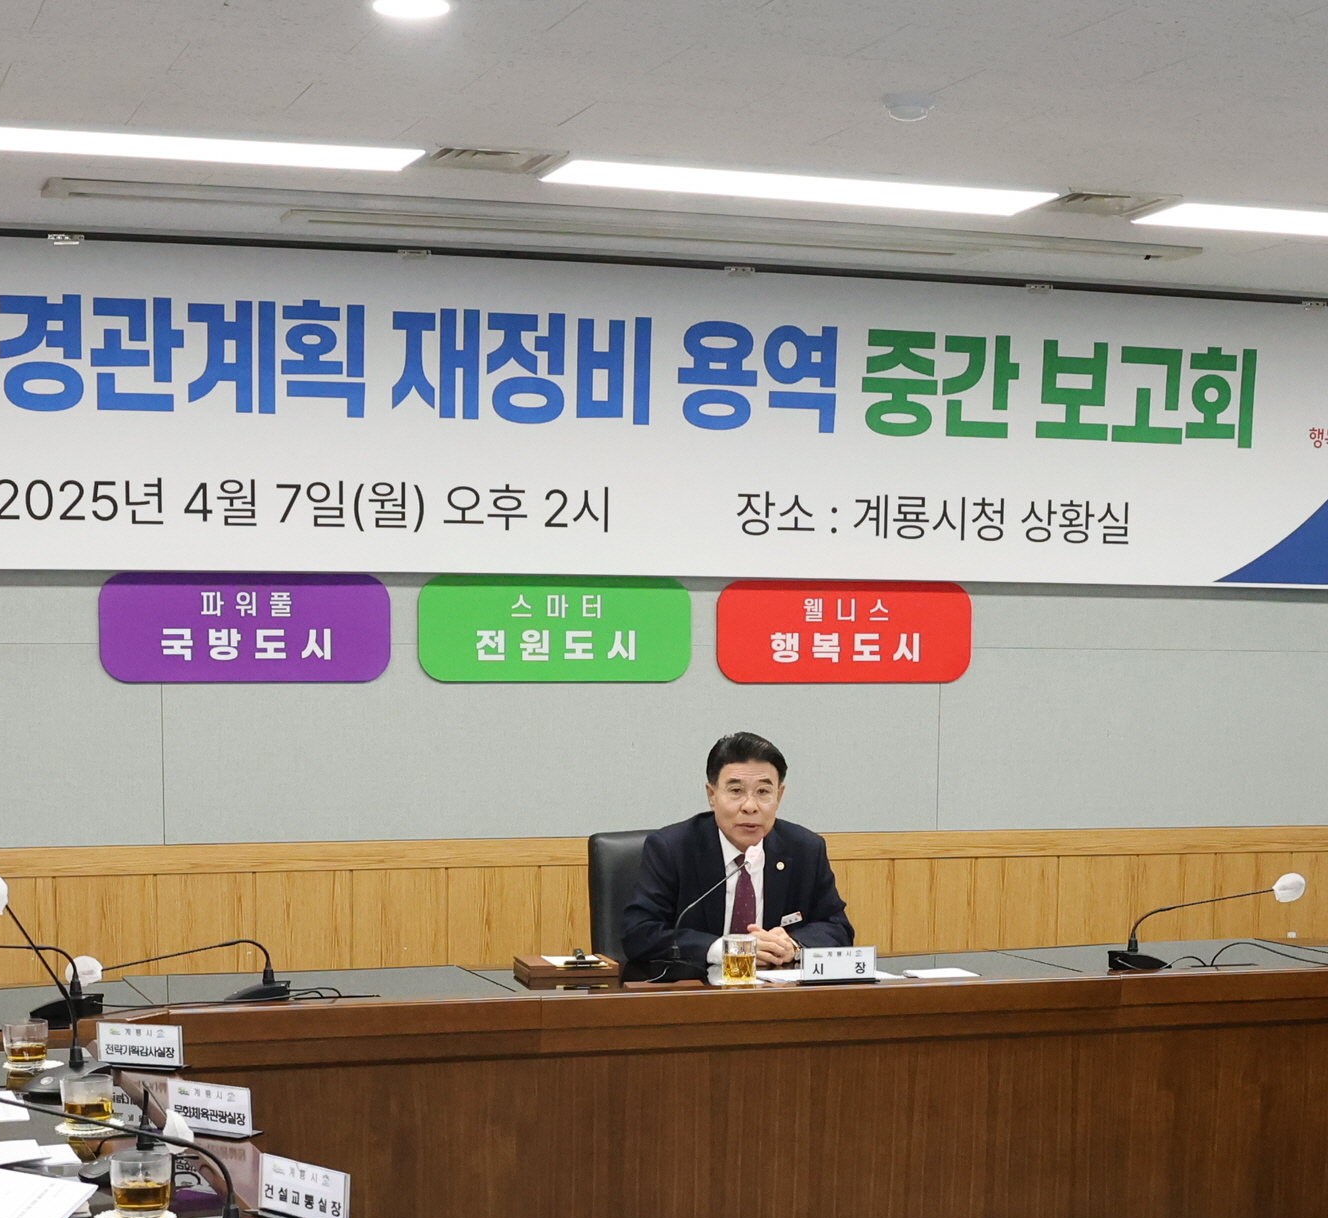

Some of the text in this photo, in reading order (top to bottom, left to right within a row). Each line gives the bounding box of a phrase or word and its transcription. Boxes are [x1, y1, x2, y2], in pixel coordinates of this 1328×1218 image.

[392, 308, 652, 426] 재정비
[678, 320, 838, 434] 용역
[861, 329, 1019, 439] 중간
[1035, 339, 1257, 449] 보고회
[184, 478, 258, 527] 4월
[276, 479, 425, 533] 7일(월)
[443, 483, 528, 531] 오후
[544, 485, 611, 533] 2시
[736, 490, 815, 536] 장소
[853, 494, 1005, 542] 계룡시청
[1020, 499, 1130, 545] 상황실
[200, 591, 292, 617] 파워풀
[510, 594, 601, 619] 스마터
[803, 598, 889, 622] 웰니스
[160, 628, 332, 661] 국방도시
[475, 629, 636, 661] 전원도시
[770, 632, 920, 663] 행복도시
[104, 1043, 175, 1059] 전략기획감사실장
[174, 1104, 246, 1126] 문화체육관광실장
[264, 1183, 342, 1217] 건설교통실장
